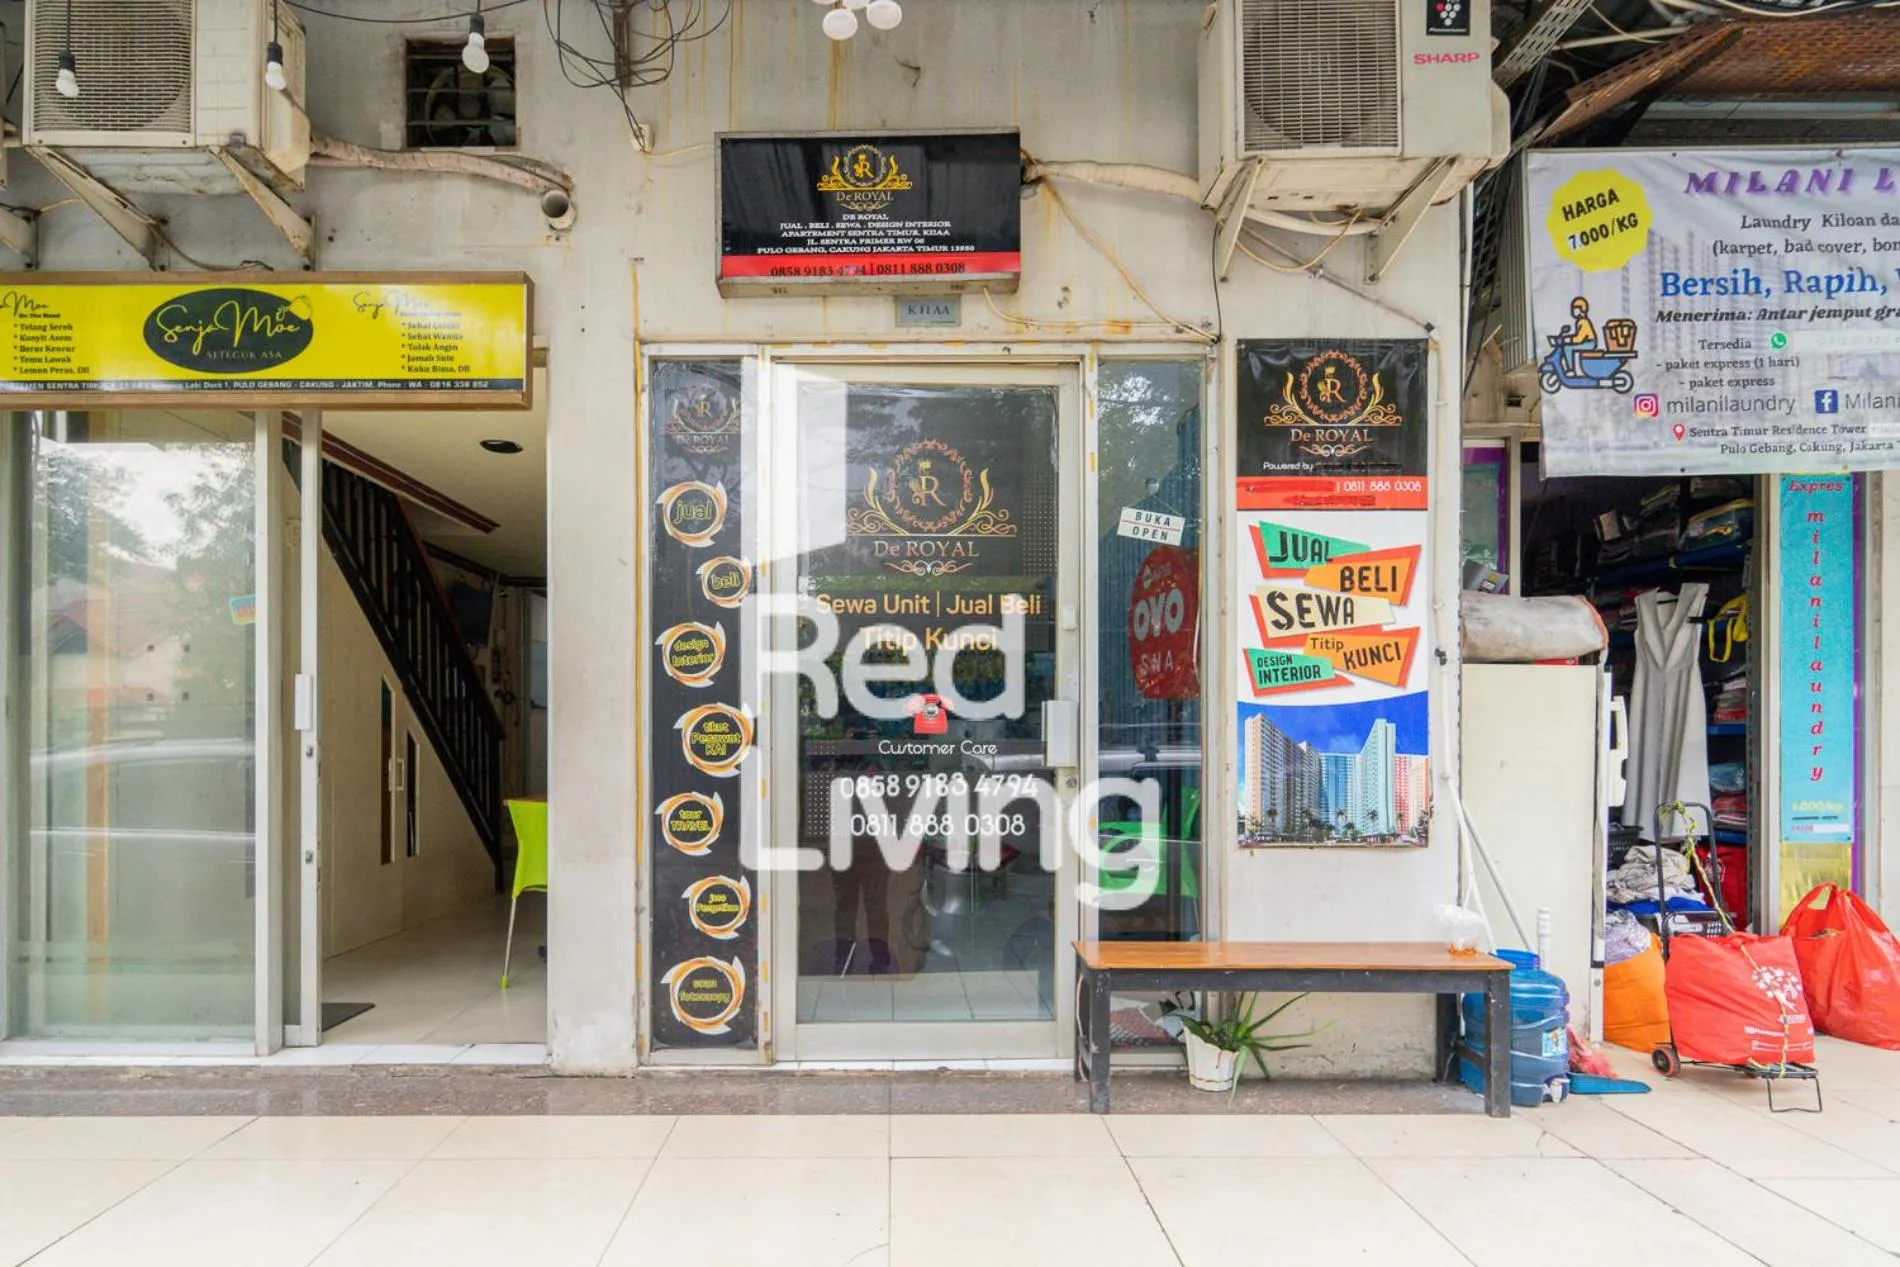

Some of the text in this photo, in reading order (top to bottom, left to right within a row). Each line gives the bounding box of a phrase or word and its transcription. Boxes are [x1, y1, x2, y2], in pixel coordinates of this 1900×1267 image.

[1413, 51, 1480, 65] SHARP
[1684, 167, 1854, 195] MILANI
[836, 191, 893, 201] De ROYAL
[1562, 188, 1620, 221] HARGA
[1741, 214, 1811, 231] Laundry
[1821, 212, 1877, 228] Kiloan
[1712, 240, 1778, 257] (karpet,
[1784, 238, 1813, 254] bad
[1817, 242, 1867, 255] cover,
[878, 263, 906, 274] 0811
[911, 262, 932, 273] 888
[936, 261, 965, 273] 0308
[1660, 266, 1887, 300] Bersih, Rapih,
[1656, 308, 1752, 323] Menerima:
[1756, 306, 1807, 322] Antar
[1809, 306, 1871, 323] jemput
[1698, 339, 1752, 350] Tersedia
[1665, 359, 1700, 372] paket
[1704, 359, 1750, 371] express
[1690, 377, 1775, 390] paket express
[1666, 396, 1796, 416] milanilaundry
[1291, 429, 1373, 442] De ROYAL
[1689, 424, 1866, 437] Sentra Timur Residence Tower
[1721, 443, 1746, 454] Pulo
[1263, 461, 1314, 473] Powered by
[1343, 481, 1365, 492] 0811
[1790, 479, 1844, 496] Expres
[1134, 511, 1171, 527] BUKA
[1132, 526, 1168, 541] OPEN
[874, 541, 979, 557] De ROYAL
[1269, 531, 1333, 563] JUAL
[1339, 565, 1398, 593] BELI
[815, 594, 1041, 615] Sewa Unit Jual Beli
[1266, 590, 1354, 631] SEWA
[860, 627, 997, 656] Titip Kunci
[1310, 637, 1344, 653] Titip
[1806, 509, 1825, 782] milanilaundry
[1257, 654, 1293, 668] DESIGN
[1343, 641, 1402, 671] KUNCI
[1258, 664, 1321, 685] INTERIOR
[878, 739, 998, 755] Customer Care
[840, 773, 1039, 798] 0858 9183 4794
[850, 814, 1026, 836] 0811 888 0308
